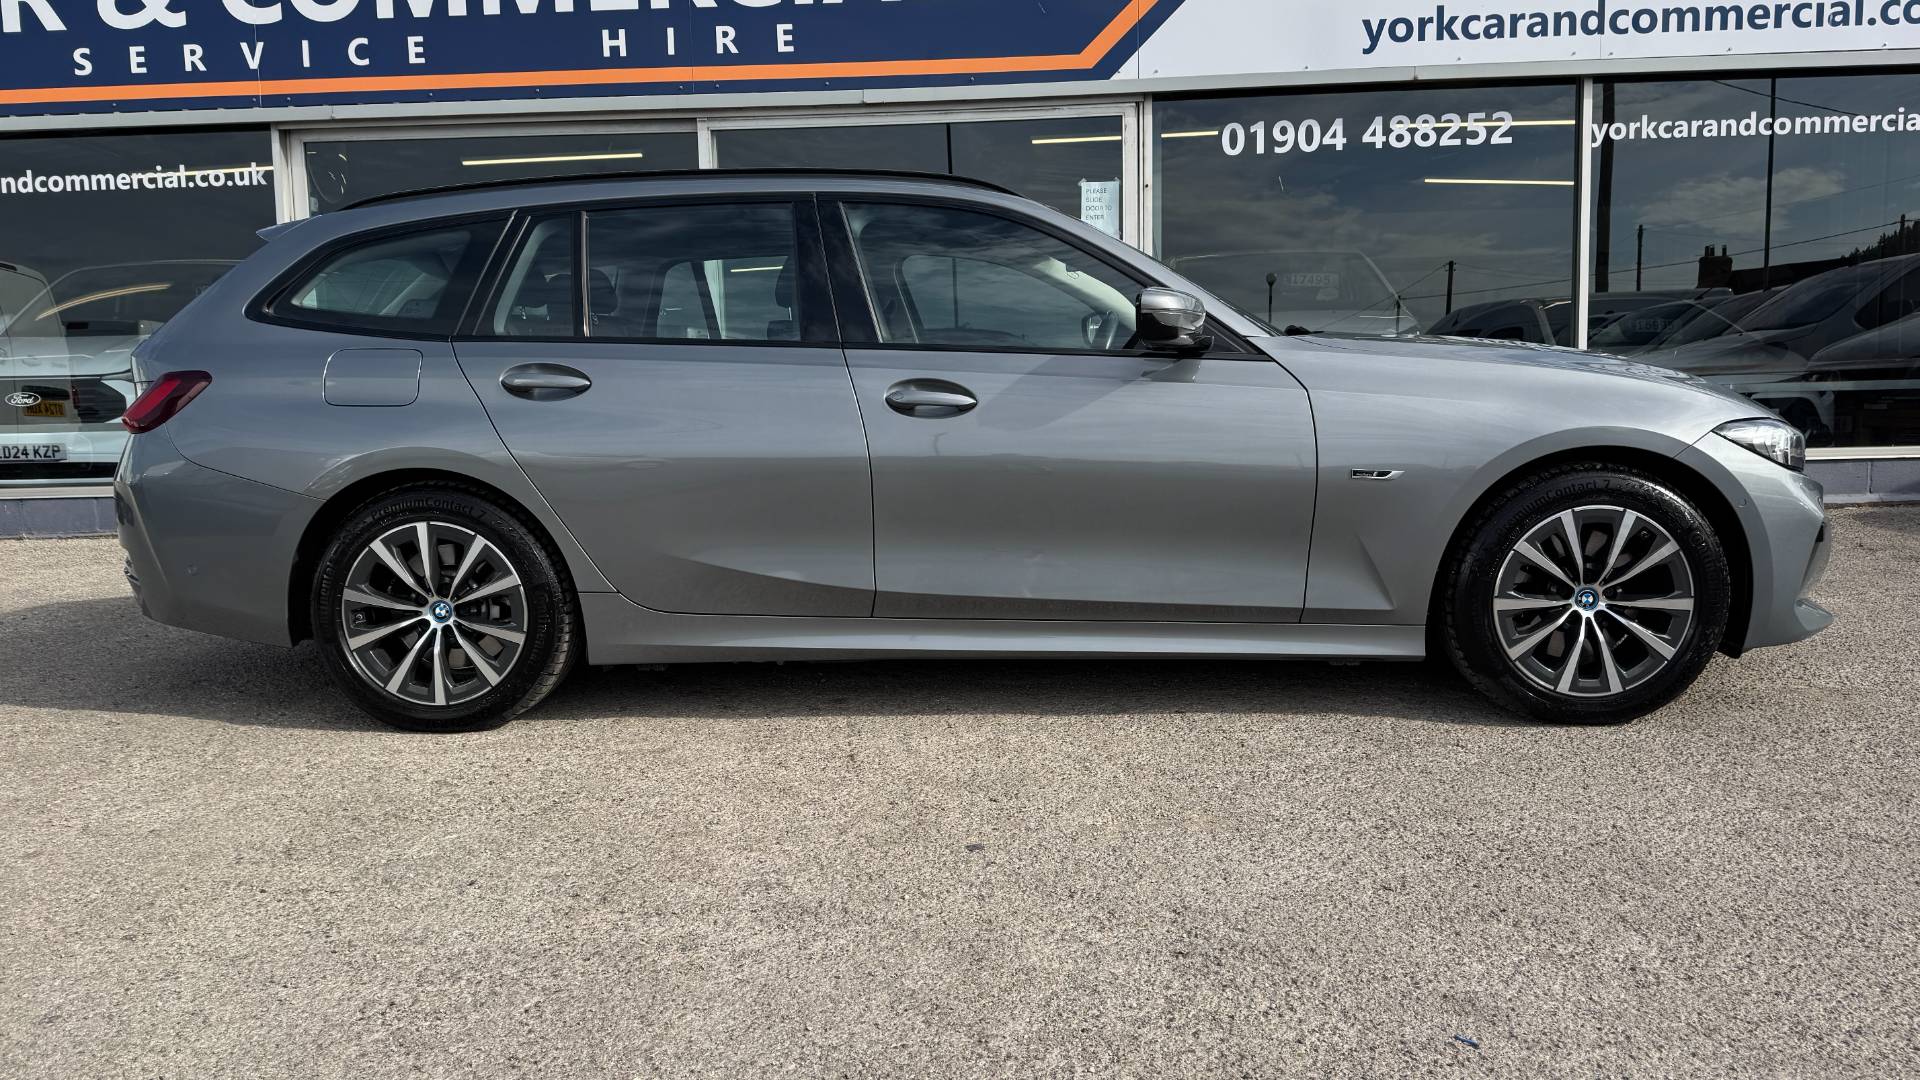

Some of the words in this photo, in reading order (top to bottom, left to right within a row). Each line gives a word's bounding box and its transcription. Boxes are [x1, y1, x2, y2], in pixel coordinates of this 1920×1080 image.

[73, 35, 426, 76] SERVICE
[602, 24, 794, 57] HIRE
[1221, 121, 1347, 156] 01904
[1362, 110, 1513, 149] 488252
[0, 162, 268, 194] ndcommercial.co.uk
[0, 445, 29, 459] D24
[32, 445, 61, 459] KZP
